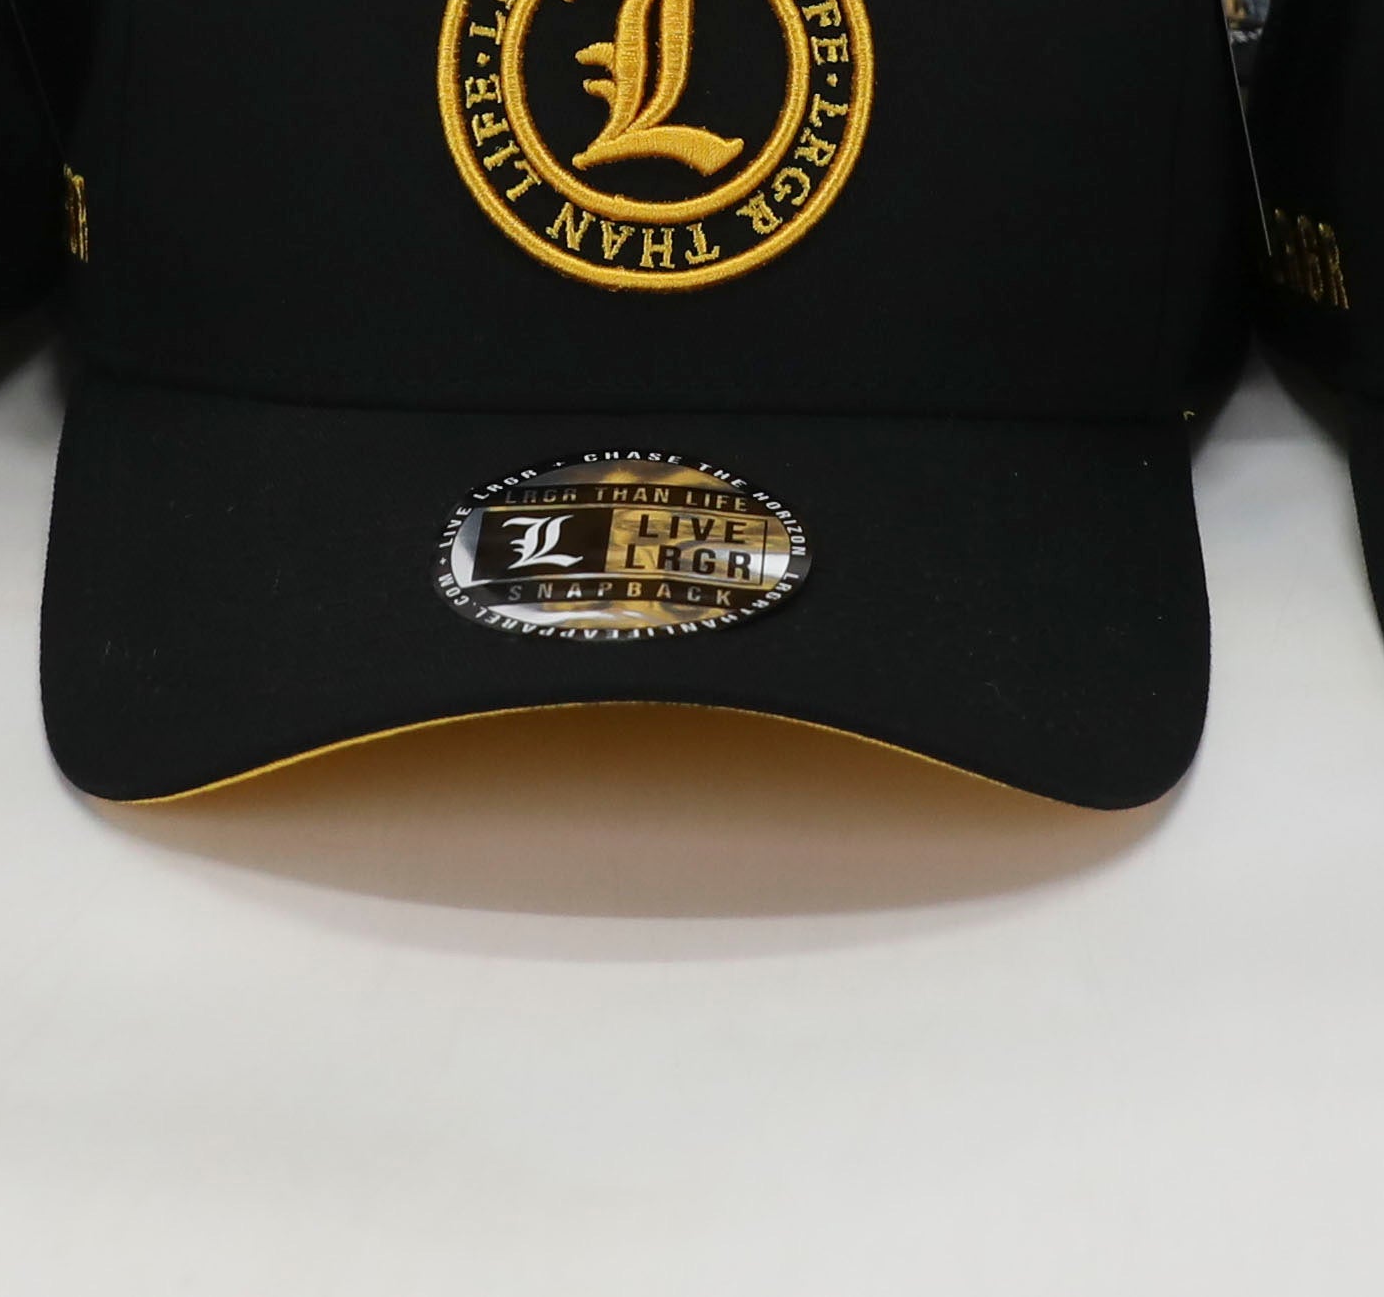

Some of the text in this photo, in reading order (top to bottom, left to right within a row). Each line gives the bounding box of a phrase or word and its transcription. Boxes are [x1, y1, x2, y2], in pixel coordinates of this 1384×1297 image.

[465, 72, 850, 270] LRGR THAN LIFE
[439, 451, 806, 556] LIVE LRGR CHASE THE HORIZON
[504, 487, 748, 512] LRGR THAN LIFE
[501, 514, 584, 569] L
[638, 514, 747, 544] LIVE
[625, 543, 752, 581] LRGR
[508, 582, 732, 606] SNAPBACK
